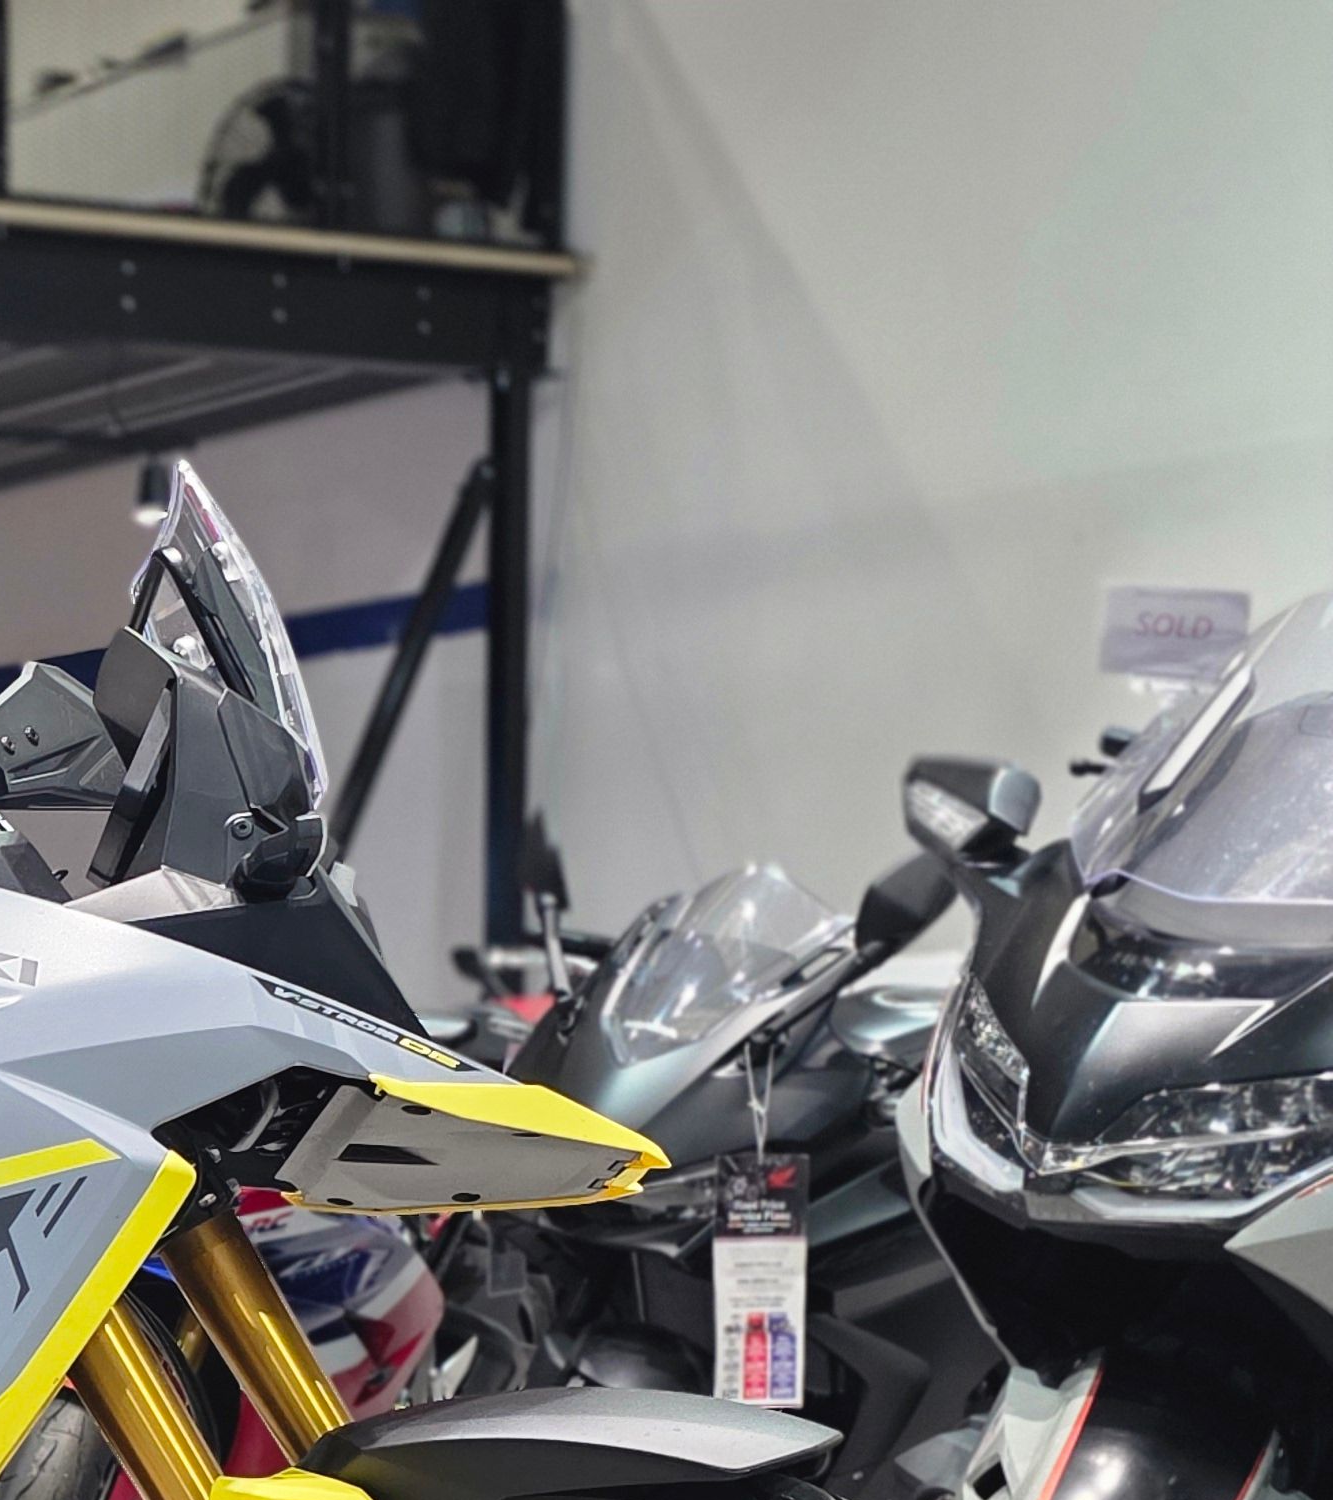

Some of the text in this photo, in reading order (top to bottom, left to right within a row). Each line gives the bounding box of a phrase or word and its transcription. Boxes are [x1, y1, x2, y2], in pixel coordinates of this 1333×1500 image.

[1135, 611, 1214, 639] SOLD
[728, 1211, 792, 1221] Service Plans
